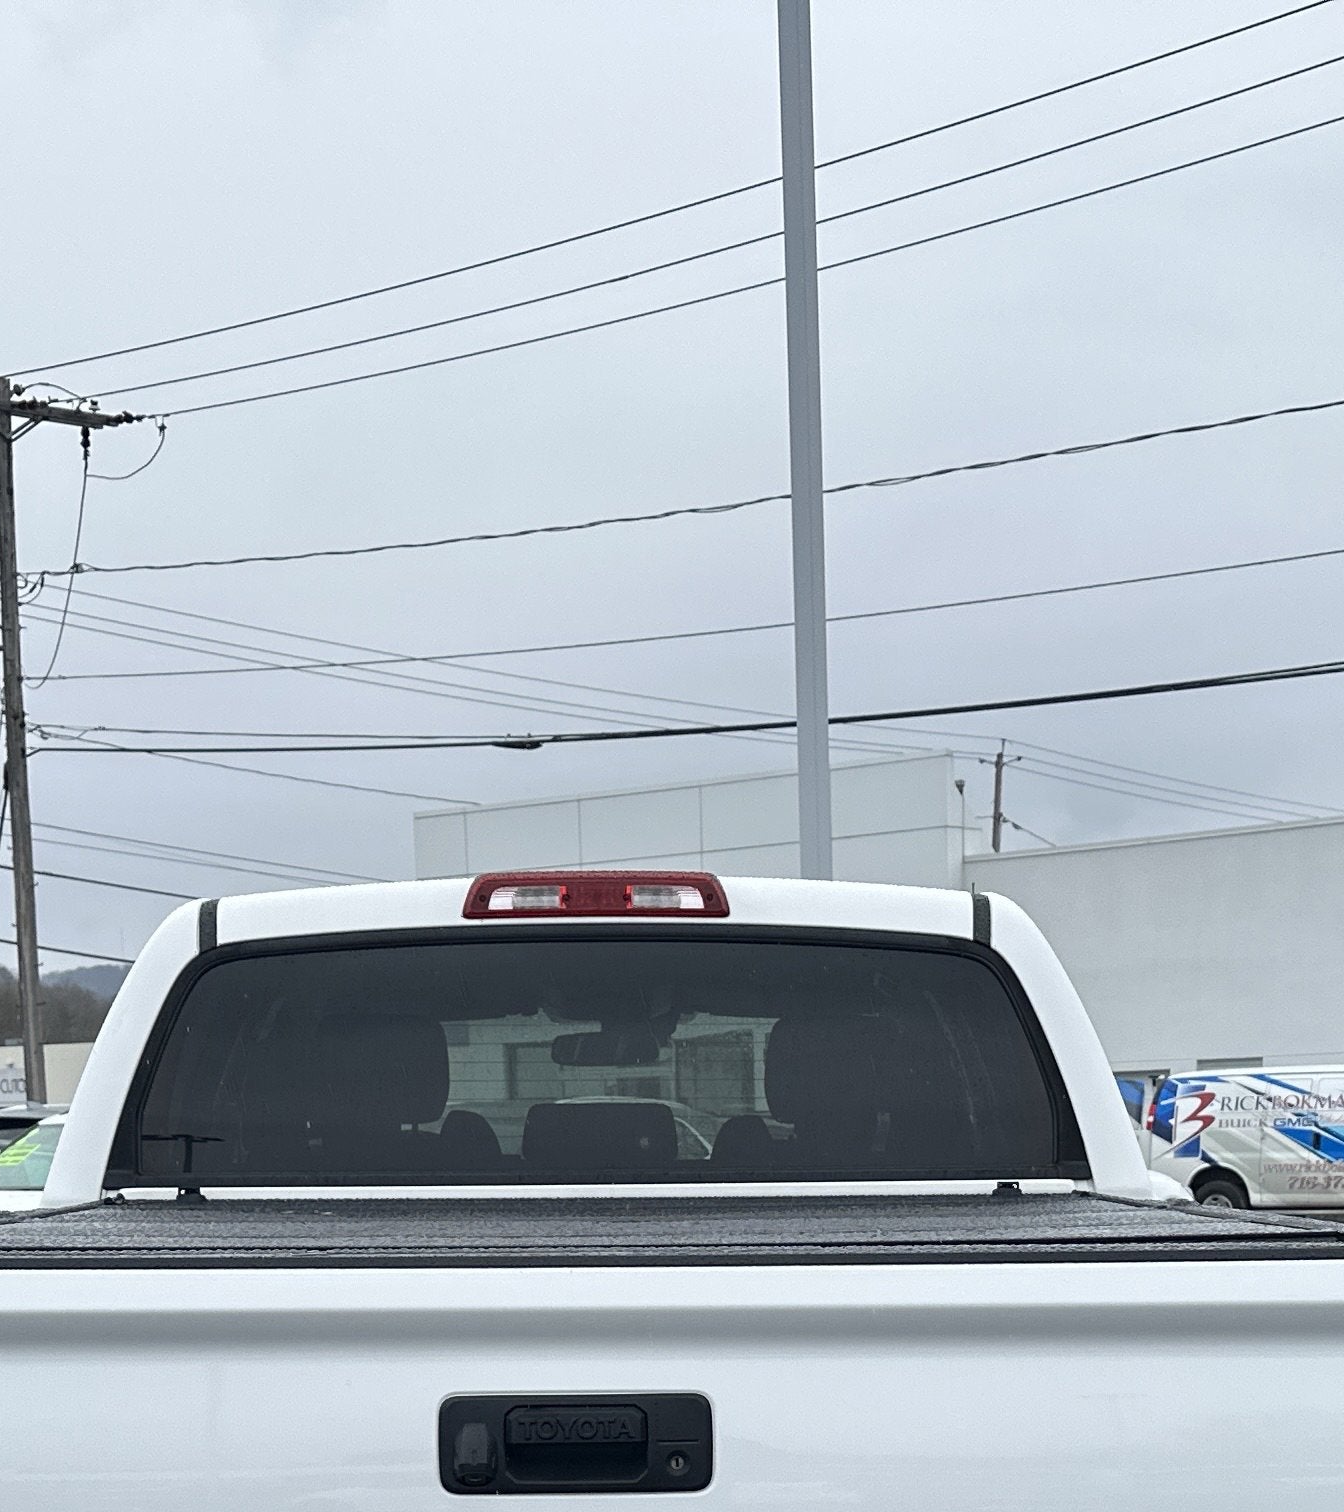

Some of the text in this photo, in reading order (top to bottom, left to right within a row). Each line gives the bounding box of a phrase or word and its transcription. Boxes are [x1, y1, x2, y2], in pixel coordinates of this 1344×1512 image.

[1220, 1095, 1269, 1112] RICK
[1218, 1118, 1271, 1129] BUICK
[1273, 1117, 1316, 1128] GMC
[517, 1415, 636, 1441] TOYOTA
